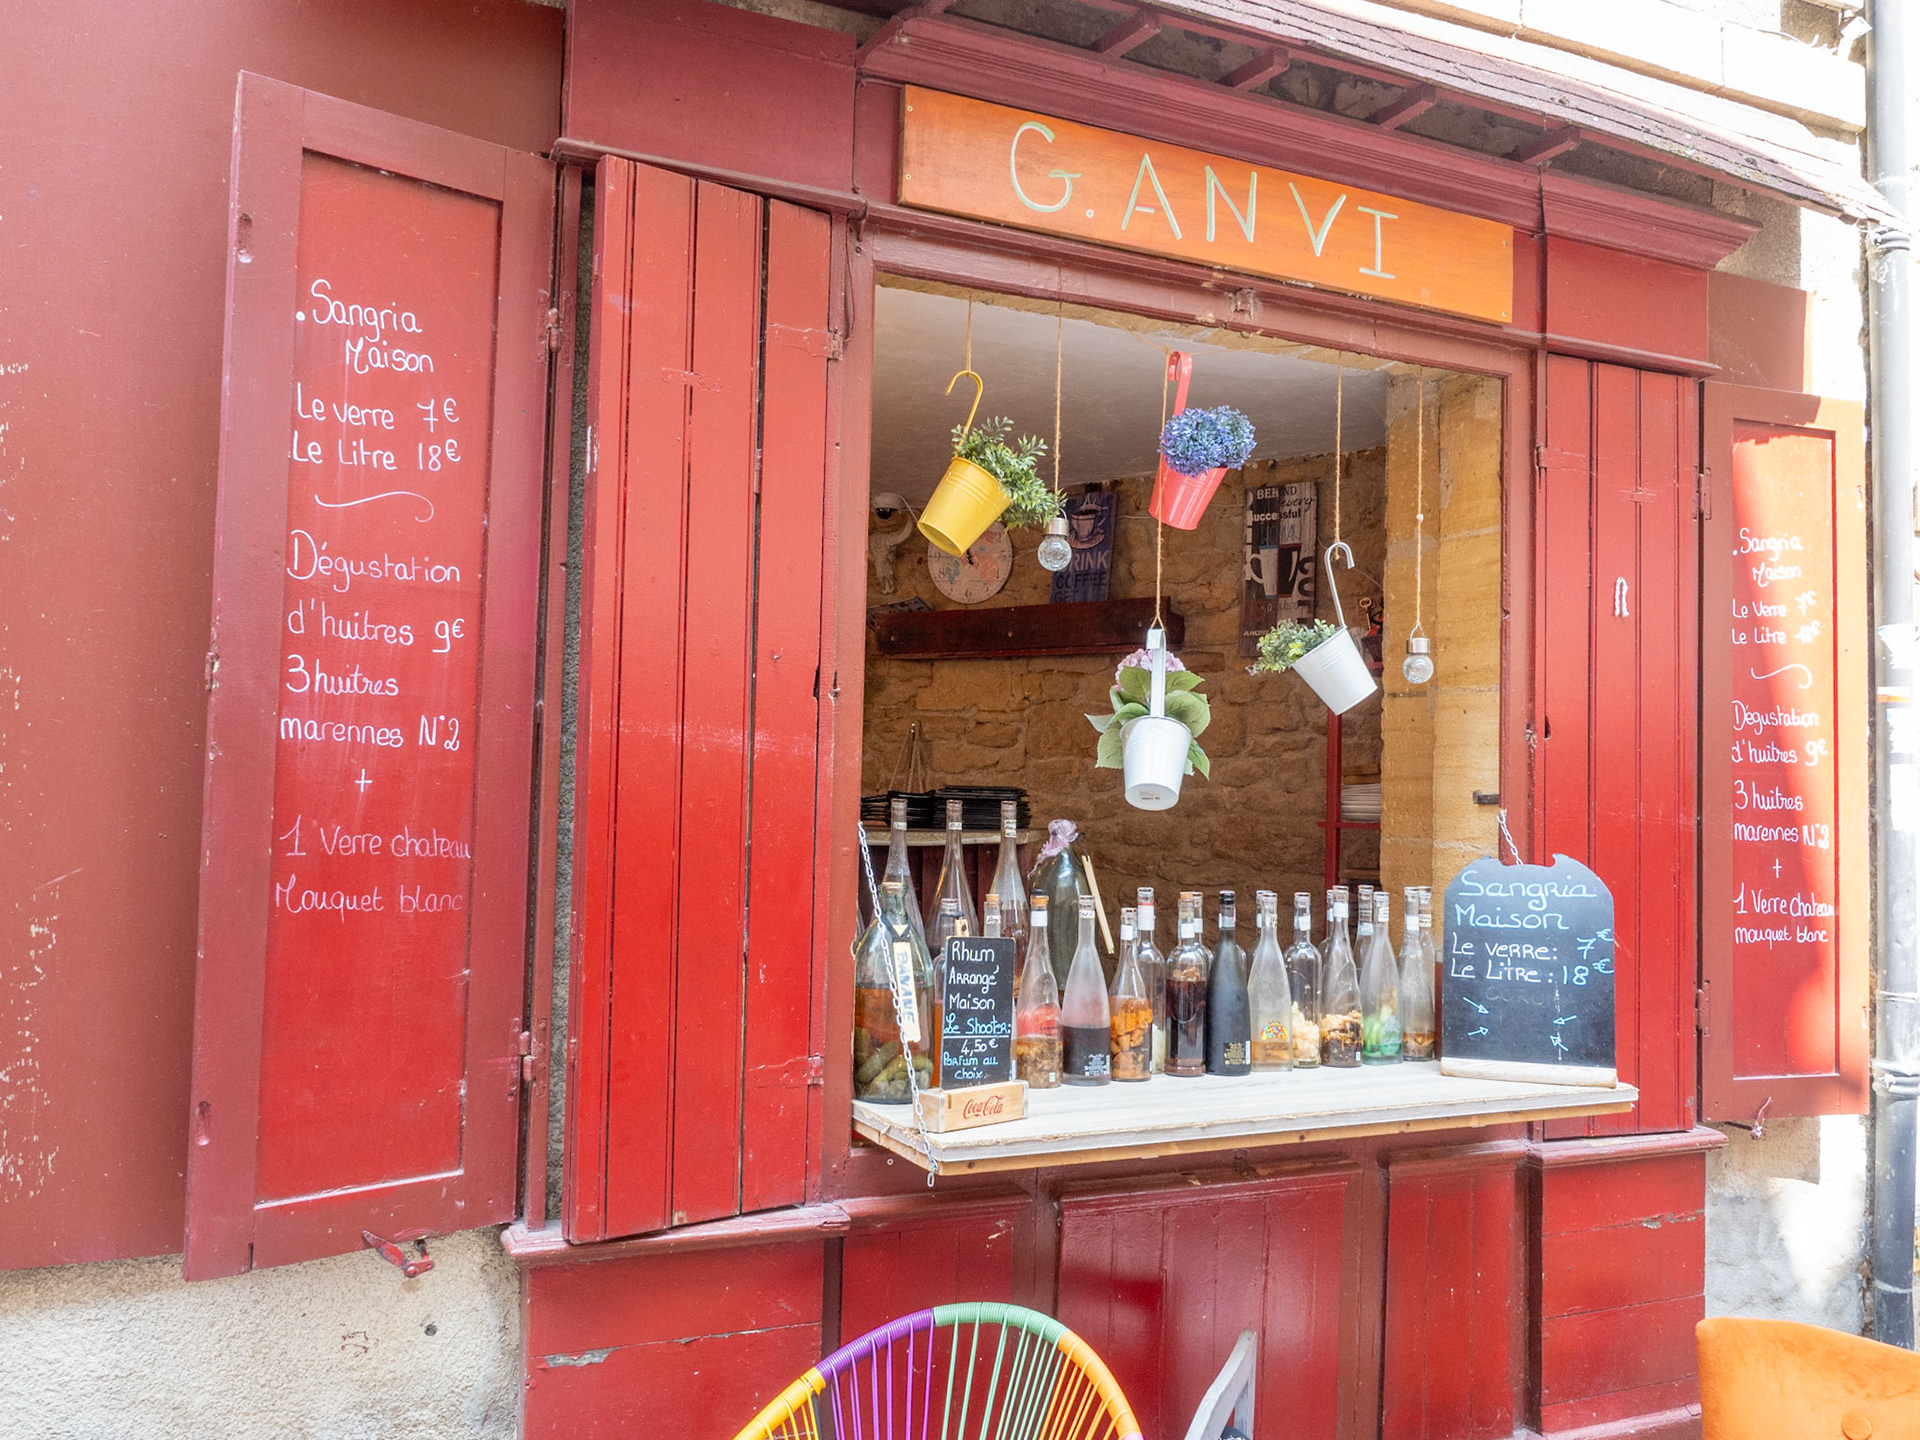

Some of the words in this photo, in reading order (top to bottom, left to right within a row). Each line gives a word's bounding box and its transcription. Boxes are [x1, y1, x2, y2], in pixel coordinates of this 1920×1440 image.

[311, 278, 423, 343] Sangria
[345, 336, 434, 375] Maison
[297, 382, 327, 421] Le
[332, 401, 395, 430] verre
[416, 397, 460, 433] 7€
[292, 430, 324, 464] Le
[338, 438, 398, 471] Litre
[418, 438, 462, 472] 18€
[1256, 485, 1298, 500] BEHND
[1740, 527, 1804, 562] Sangria
[286, 529, 461, 593] Dégustation
[1061, 549, 1110, 572] RINK
[1751, 561, 1802, 588] Maison
[1732, 598, 1749, 618] Le
[431, 618, 466, 653] 9€
[1731, 628, 1748, 645] Le
[279, 717, 405, 748] marennes
[1731, 699, 1820, 736] Dégustation
[1733, 779, 1749, 810] 3
[279, 814, 307, 857] 1
[1733, 821, 1800, 843] marennes
[399, 884, 464, 913] blanc
[1458, 868, 1598, 912] Sangria
[1732, 881, 1748, 914] 1
[1751, 888, 1788, 915] Verre
[1454, 902, 1570, 930] Maison
[1451, 931, 1476, 956] Le
[1576, 928, 1615, 961] 7€
[1796, 925, 1829, 944] blanc
[951, 940, 995, 963] Rhum
[1450, 957, 1477, 979] Le
[1561, 957, 1616, 987] 18€
[949, 992, 996, 1011] Maison
[943, 1051, 979, 1067] Parfum
[982, 1056, 999, 1066] au
[960, 1038, 999, 1058] 4,50€
